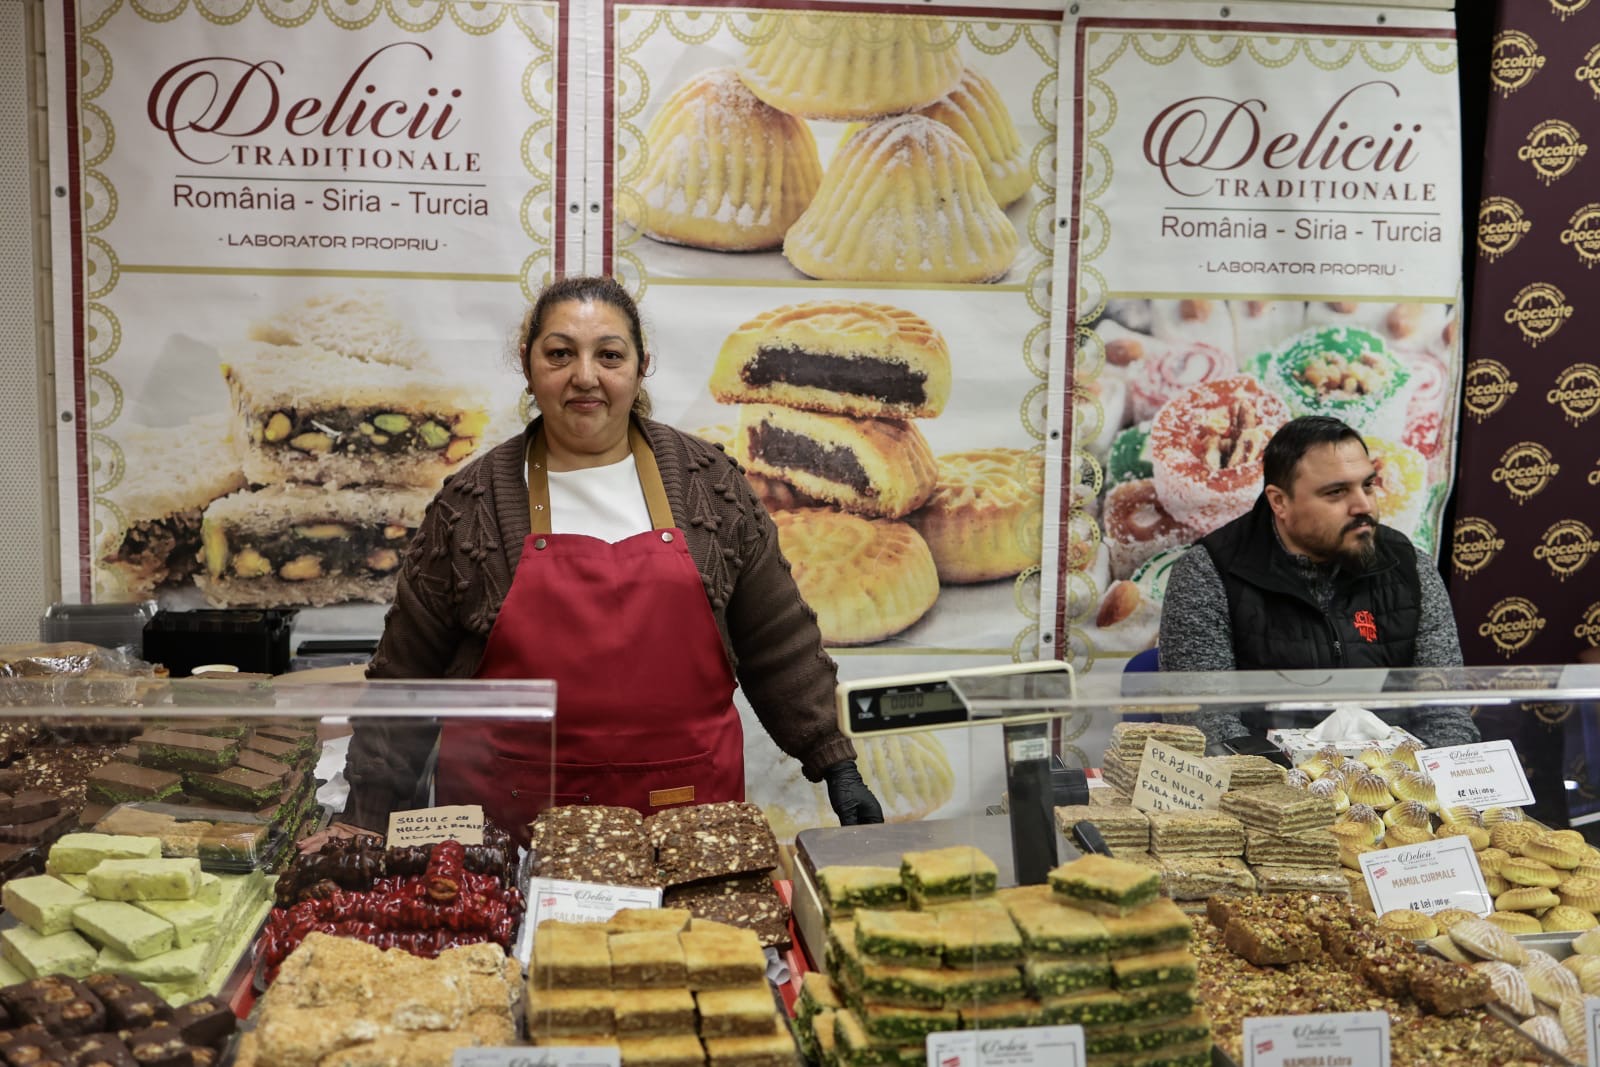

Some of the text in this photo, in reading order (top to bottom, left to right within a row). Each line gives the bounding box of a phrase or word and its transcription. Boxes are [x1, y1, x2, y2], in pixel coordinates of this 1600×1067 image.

[1492, 54, 1546, 69] ocolate
[147, 42, 462, 165] Delicii
[1143, 80, 1422, 197] Delicii
[231, 145, 482, 172] TRADIȚIONALE
[1518, 143, 1588, 161] Chocolate
[173, 184, 296, 211] România
[322, 188, 382, 213] Siria
[409, 191, 489, 216] Turcia
[1215, 178, 1438, 203] TRADIȚIONALE
[1161, 215, 1268, 239] România
[1295, 218, 1347, 240] Siria
[1372, 220, 1442, 242] Turcia
[1479, 219, 1532, 235] ocolate
[228, 234, 347, 248] LABORATOR
[352, 237, 439, 251] PROPRIU
[1207, 261, 1316, 275] LABORATOR
[1320, 263, 1397, 276] PROPRIU
[1504, 304, 1574, 324] Chocolate
[1466, 381, 1518, 396] ocolate
[1491, 462, 1560, 482] Chocolate
[1453, 537, 1505, 553] ocolate
[1533, 540, 1600, 560] Chocolate
[1479, 616, 1546, 637] Chocolate
[1450, 768, 1474, 779] MAMUL
[1391, 868, 1457, 889] MAMUL CURMALE
